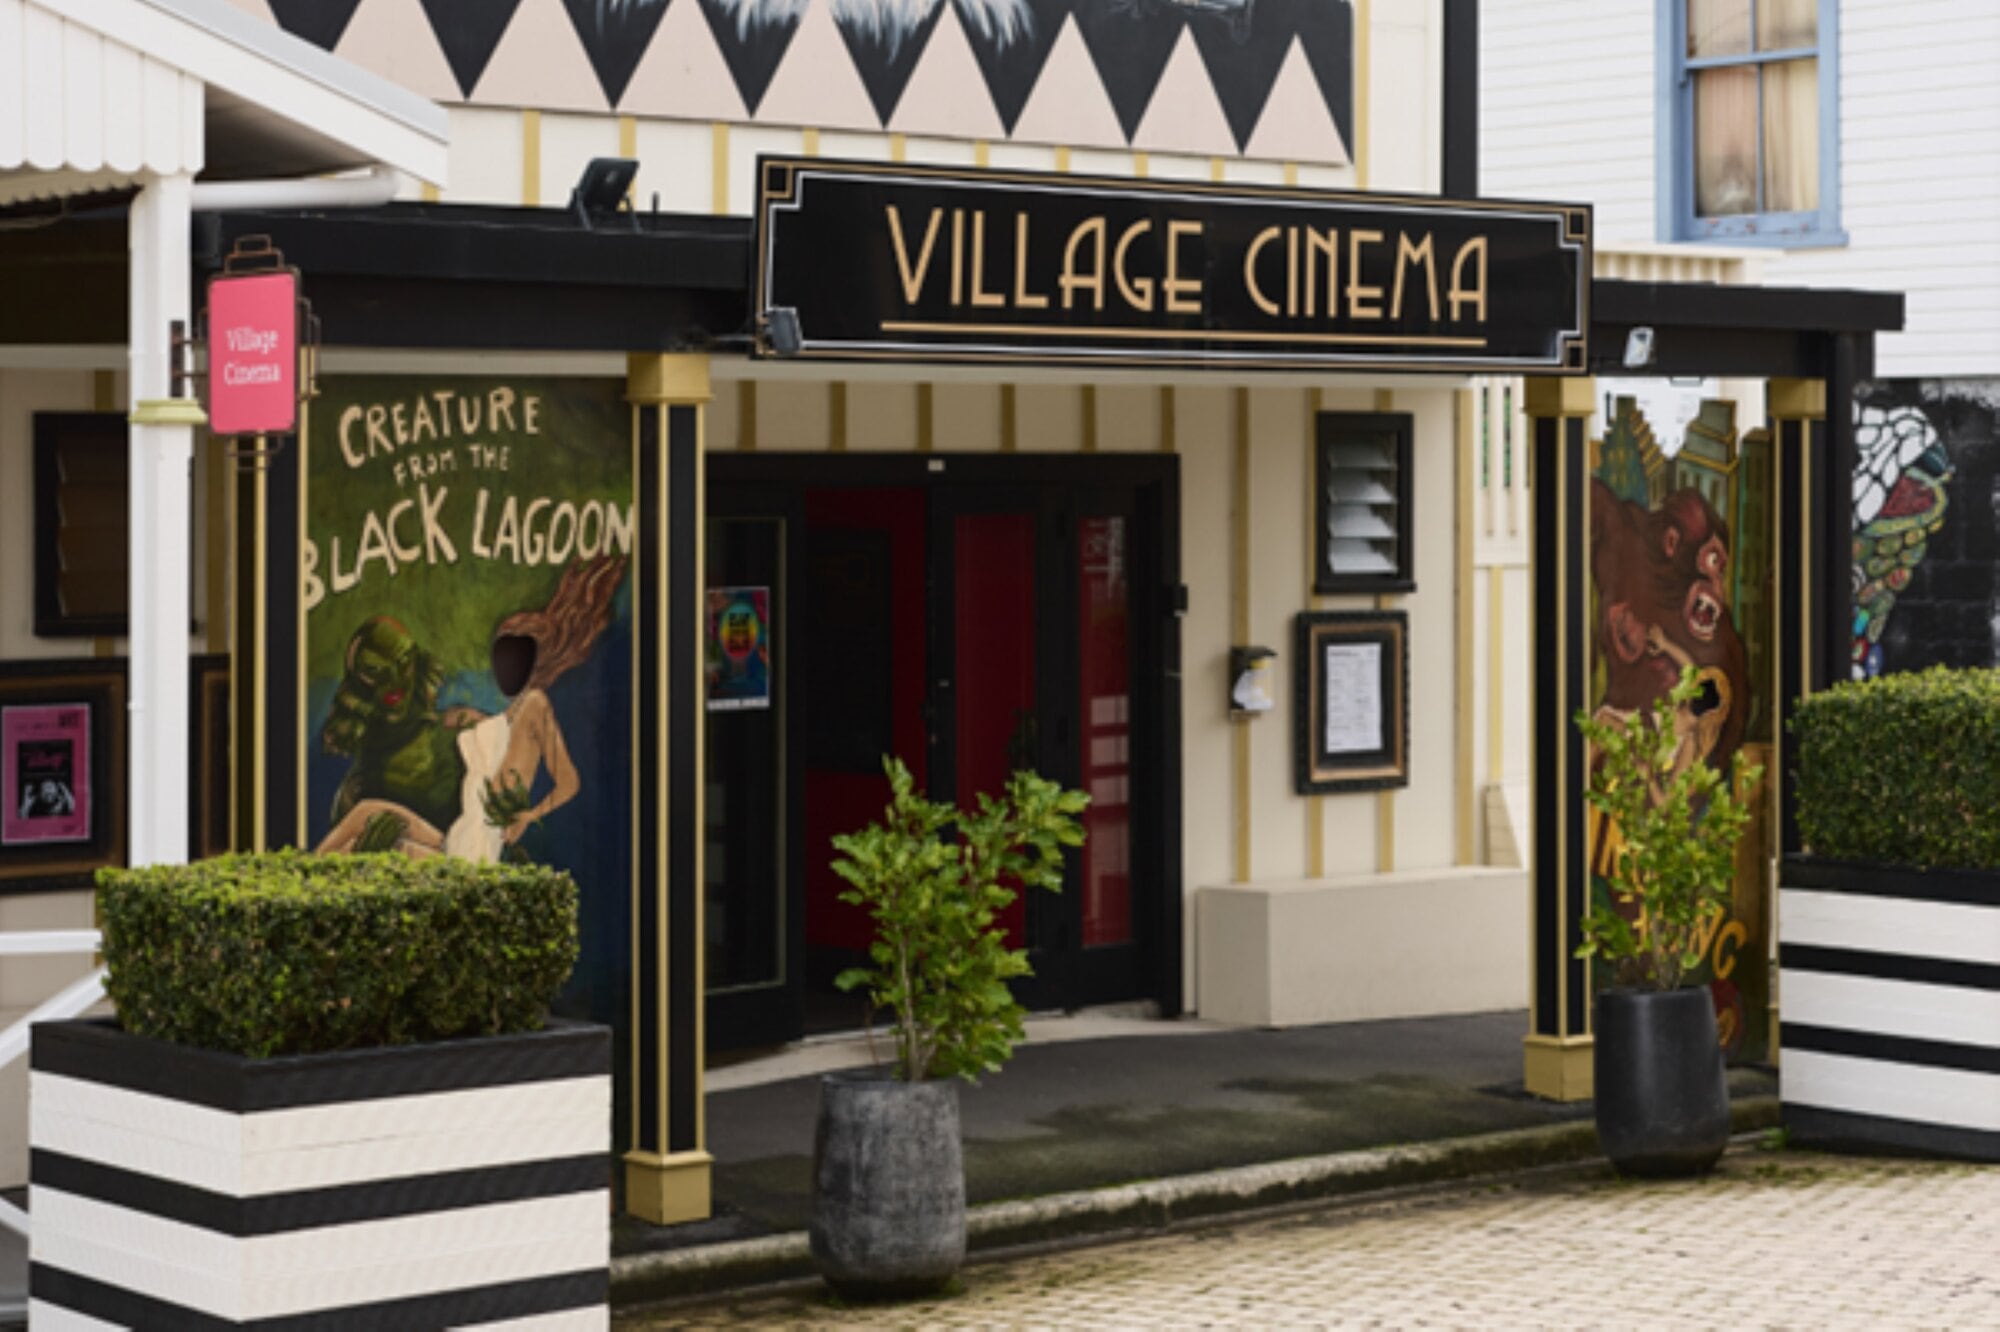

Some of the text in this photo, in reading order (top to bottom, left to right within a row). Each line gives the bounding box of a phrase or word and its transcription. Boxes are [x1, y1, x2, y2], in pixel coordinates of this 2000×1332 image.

[885, 205, 1488, 322] VILLAGE CINEMA
[225, 326, 279, 355] Village
[224, 361, 282, 386] Cinema
[338, 386, 541, 469] CREATURE
[392, 442, 510, 487] FROM THE
[304, 482, 635, 612] BLACK LAGOON
